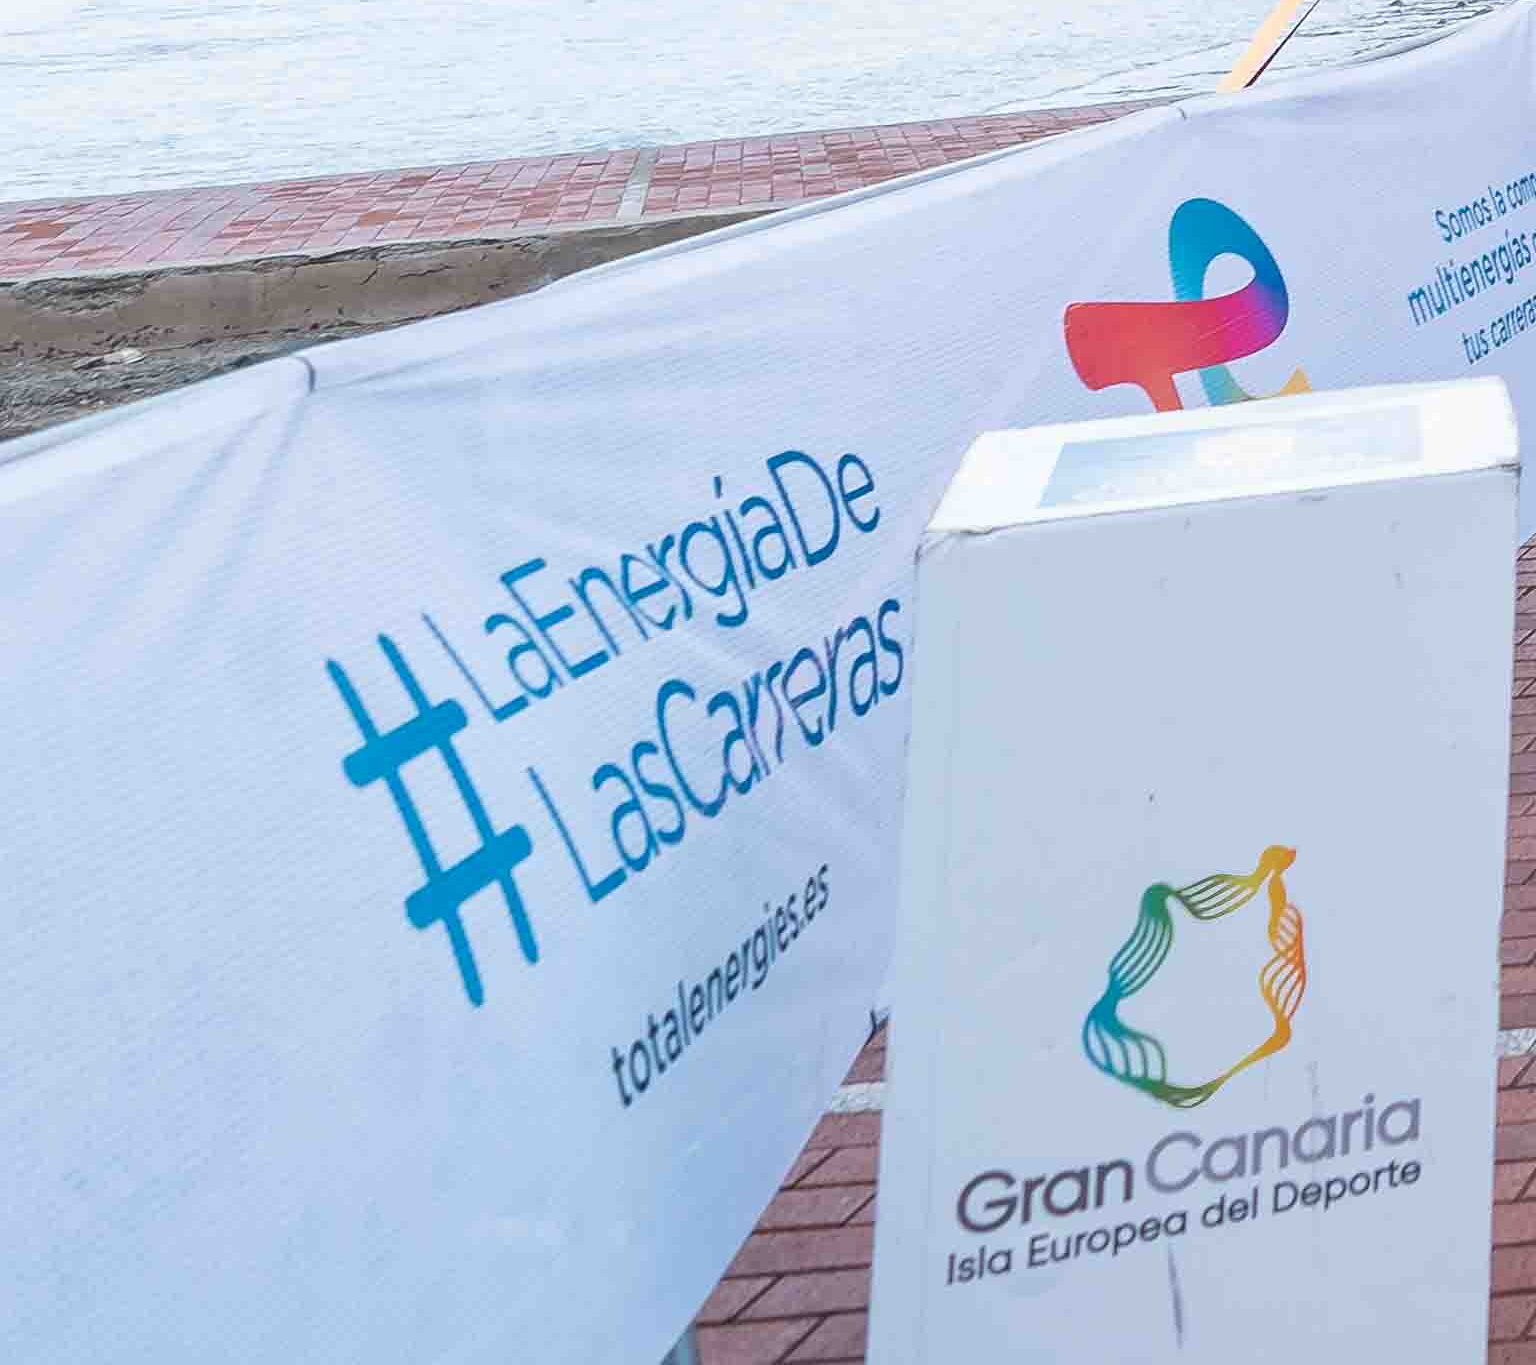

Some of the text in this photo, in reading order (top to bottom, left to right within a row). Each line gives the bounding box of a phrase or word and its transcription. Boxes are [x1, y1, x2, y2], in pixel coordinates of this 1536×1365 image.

[1407, 228, 1532, 327] multienergías
[1435, 195, 1493, 243] Somos
[1488, 185, 1508, 218] la
[1462, 327, 1489, 366] tus
[527, 598, 904, 904] LasCarreras
[610, 863, 829, 1108] totalenergies.es
[945, 1157, 1423, 1287] Isla Europea del Deporte
[955, 1093, 1423, 1235] Gran Canaria
